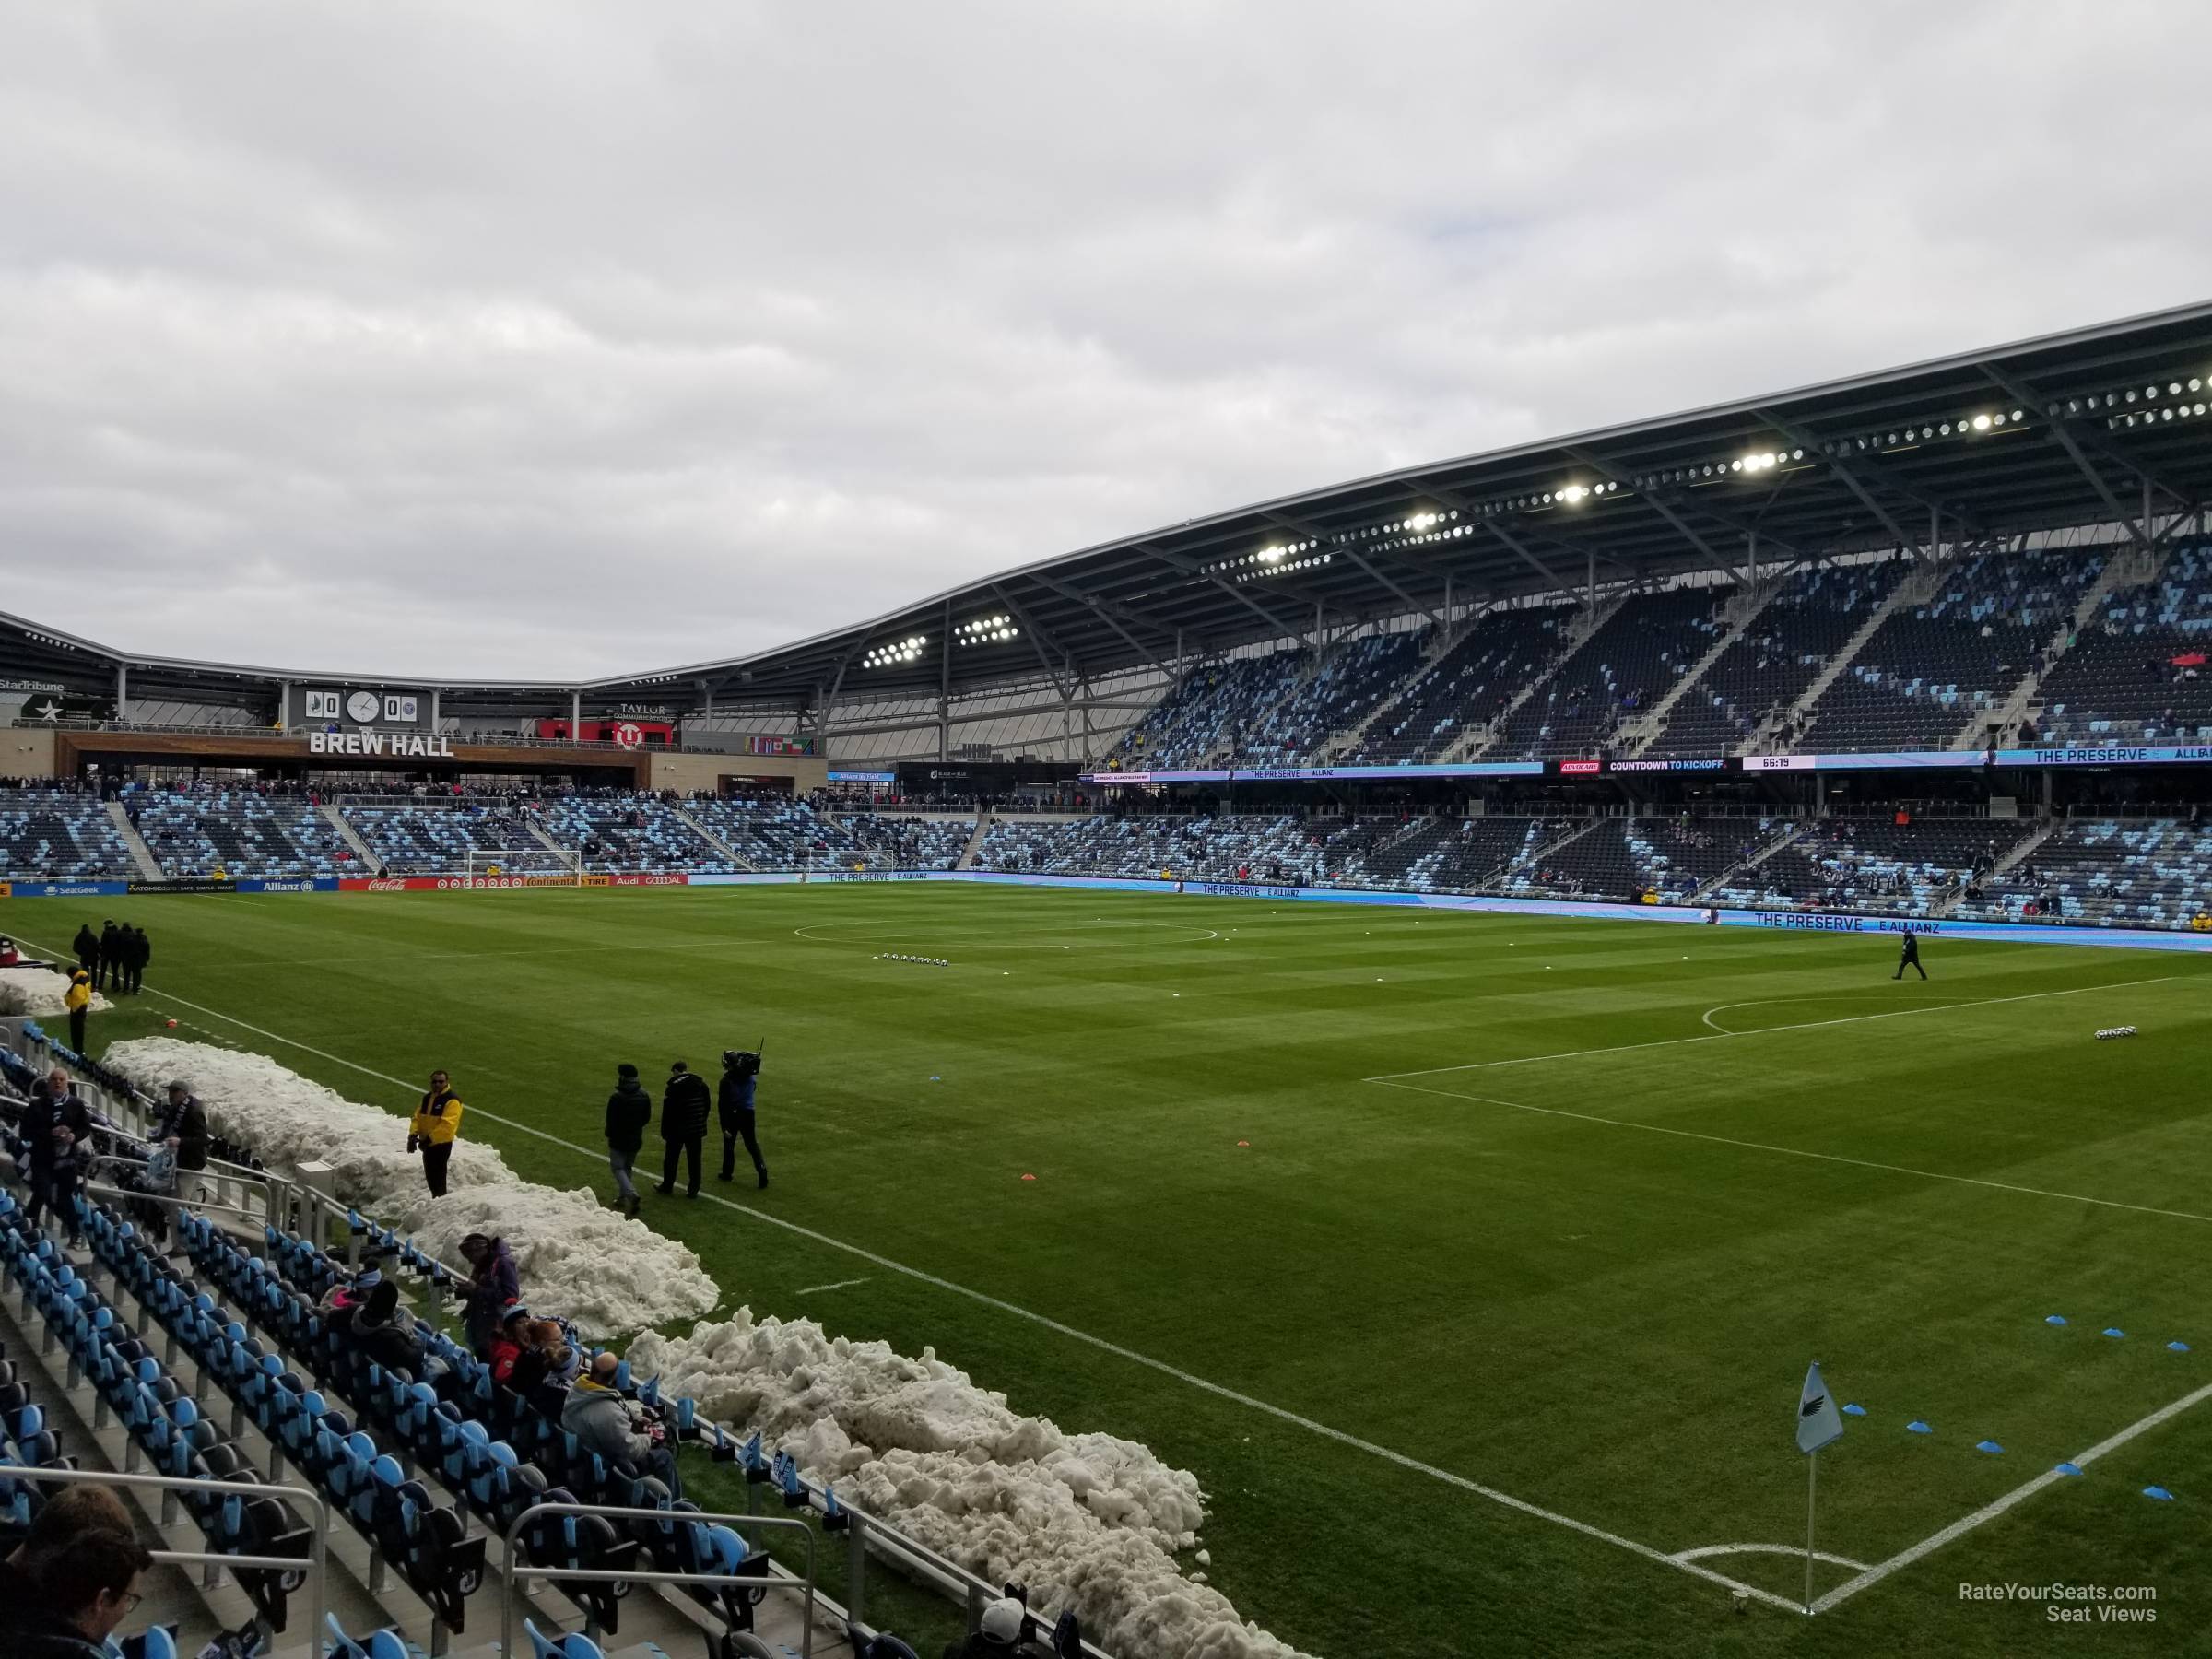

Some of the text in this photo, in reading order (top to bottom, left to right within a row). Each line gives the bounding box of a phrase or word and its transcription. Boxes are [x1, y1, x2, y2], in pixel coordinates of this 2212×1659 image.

[0, 679, 65, 691] StarTribune
[326, 697, 336, 713] 0
[388, 700, 398, 715] 0
[620, 703, 665, 714] TAYLOR
[310, 732, 453, 756] BREW HALL
[2034, 750, 2063, 762] THE
[2067, 748, 2147, 762] PRESERVE
[1610, 760, 1668, 771] COUNTDOWN
[1669, 760, 1682, 770] TO
[1763, 758, 1789, 767] 66:19
[1251, 770, 1264, 779] THE
[1265, 769, 1300, 778] PRESERVE
[526, 877, 577, 887] Continental
[616, 877, 639, 886] Audi
[830, 874, 845, 882] THE
[848, 873, 890, 881] PRESERVE
[59, 886, 99, 895] SeatGeek
[264, 882, 300, 891] Allianz
[1204, 884, 1218, 894] THE
[1219, 885, 1260, 897] PRESERVE
[1755, 912, 1783, 927] THE
[1786, 914, 1863, 931] PRESERVE
